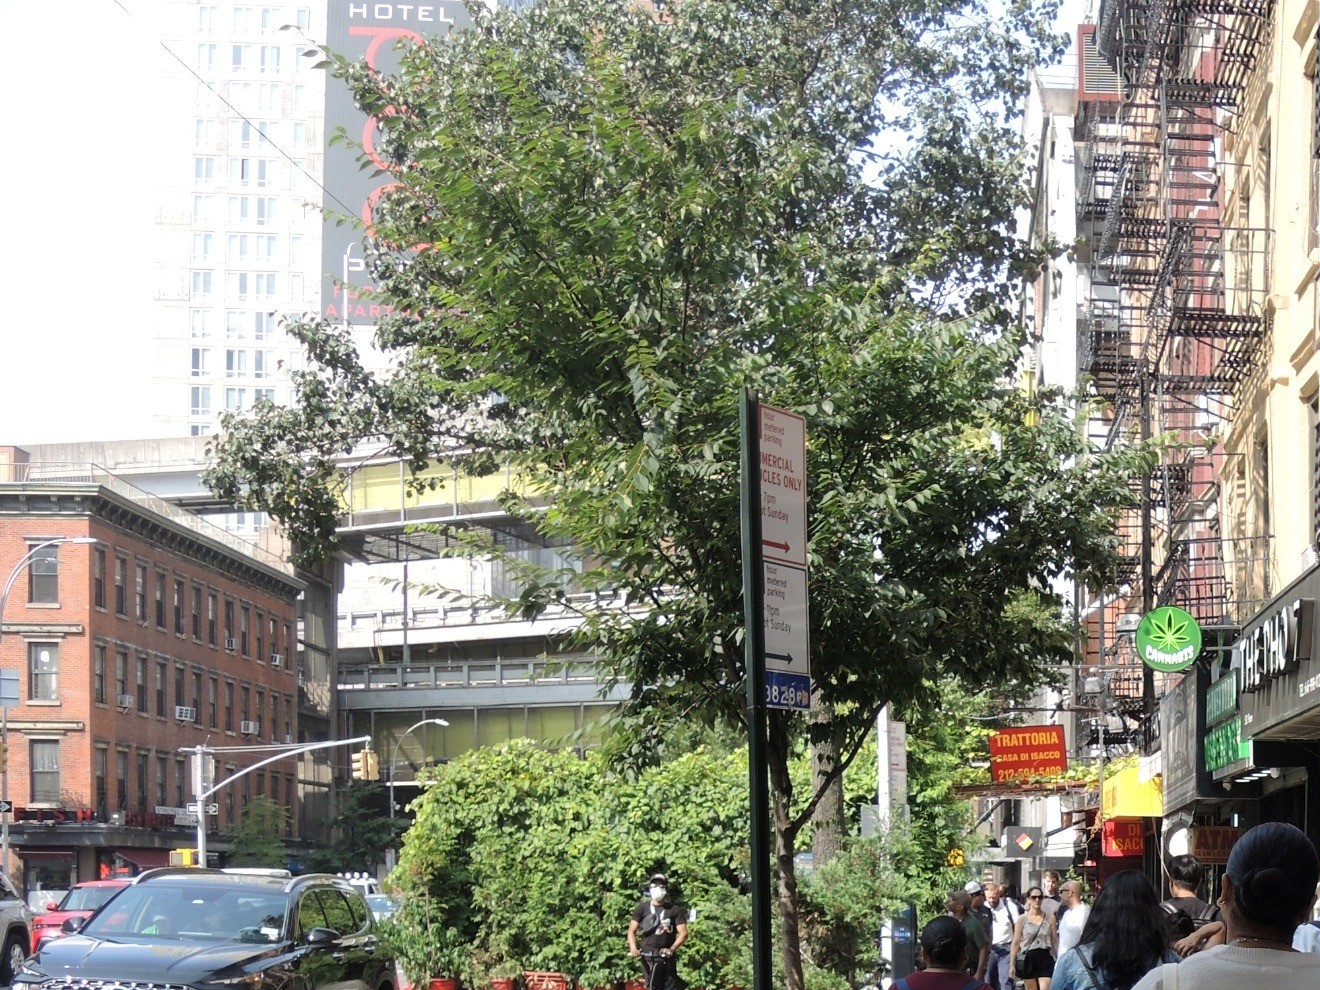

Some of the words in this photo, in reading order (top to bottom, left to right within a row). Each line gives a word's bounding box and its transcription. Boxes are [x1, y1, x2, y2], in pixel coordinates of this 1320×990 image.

[350, 3, 454, 23] HOTEL
[783, 475, 802, 492] ONLY
[767, 507, 789, 524] Sunday
[766, 587, 785, 600] parking
[770, 620, 792, 634] Sunday
[1145, 644, 1194, 665] CANNABIS
[995, 731, 1059, 747] TRATTORIA
[996, 753, 1019, 763] CASA
[1020, 752, 1029, 761] DI
[1031, 750, 1060, 760] ISACCO
[14, 807, 92, 823] FISH
[1128, 824, 1141, 836] DI
